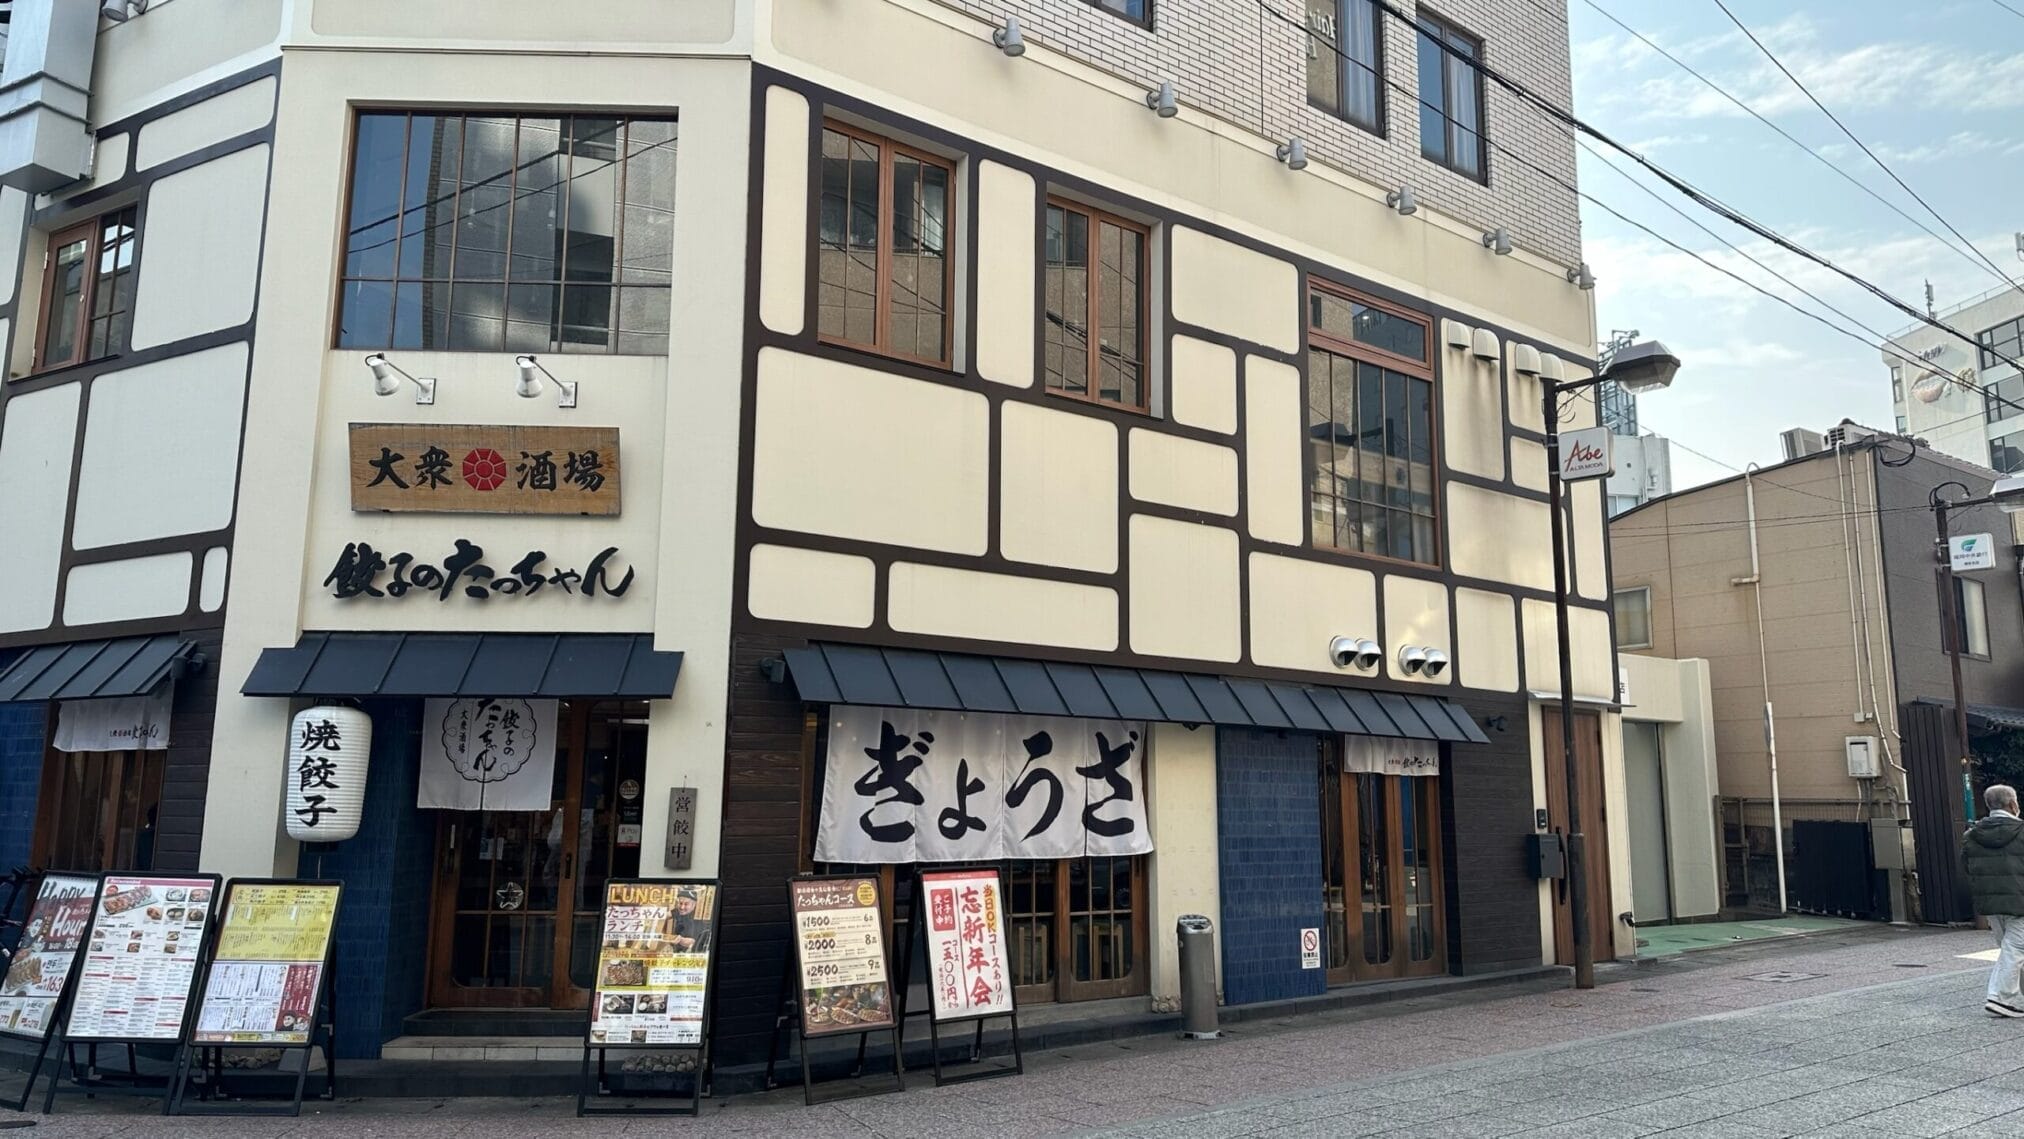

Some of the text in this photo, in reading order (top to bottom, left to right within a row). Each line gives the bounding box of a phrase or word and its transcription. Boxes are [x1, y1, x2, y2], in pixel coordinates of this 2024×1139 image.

[366, 446, 605, 492] 大衆 酒場
[1564, 440, 1603, 472] Abe
[323, 538, 635, 601] 餃子のたっちゃん
[500, 709, 520, 757] 餃子の
[294, 719, 342, 828] 焼餃子
[855, 720, 1139, 843] ぎょうざ
[671, 796, 691, 860] 営餃中
[607, 906, 664, 918] たっちゃん
[610, 888, 675, 905] LUNCH
[797, 893, 855, 908] たっちゃんコース
[50, 904, 87, 937] Hour
[607, 920, 643, 932] ランチ
[960, 886, 993, 1006] 忘新年会
